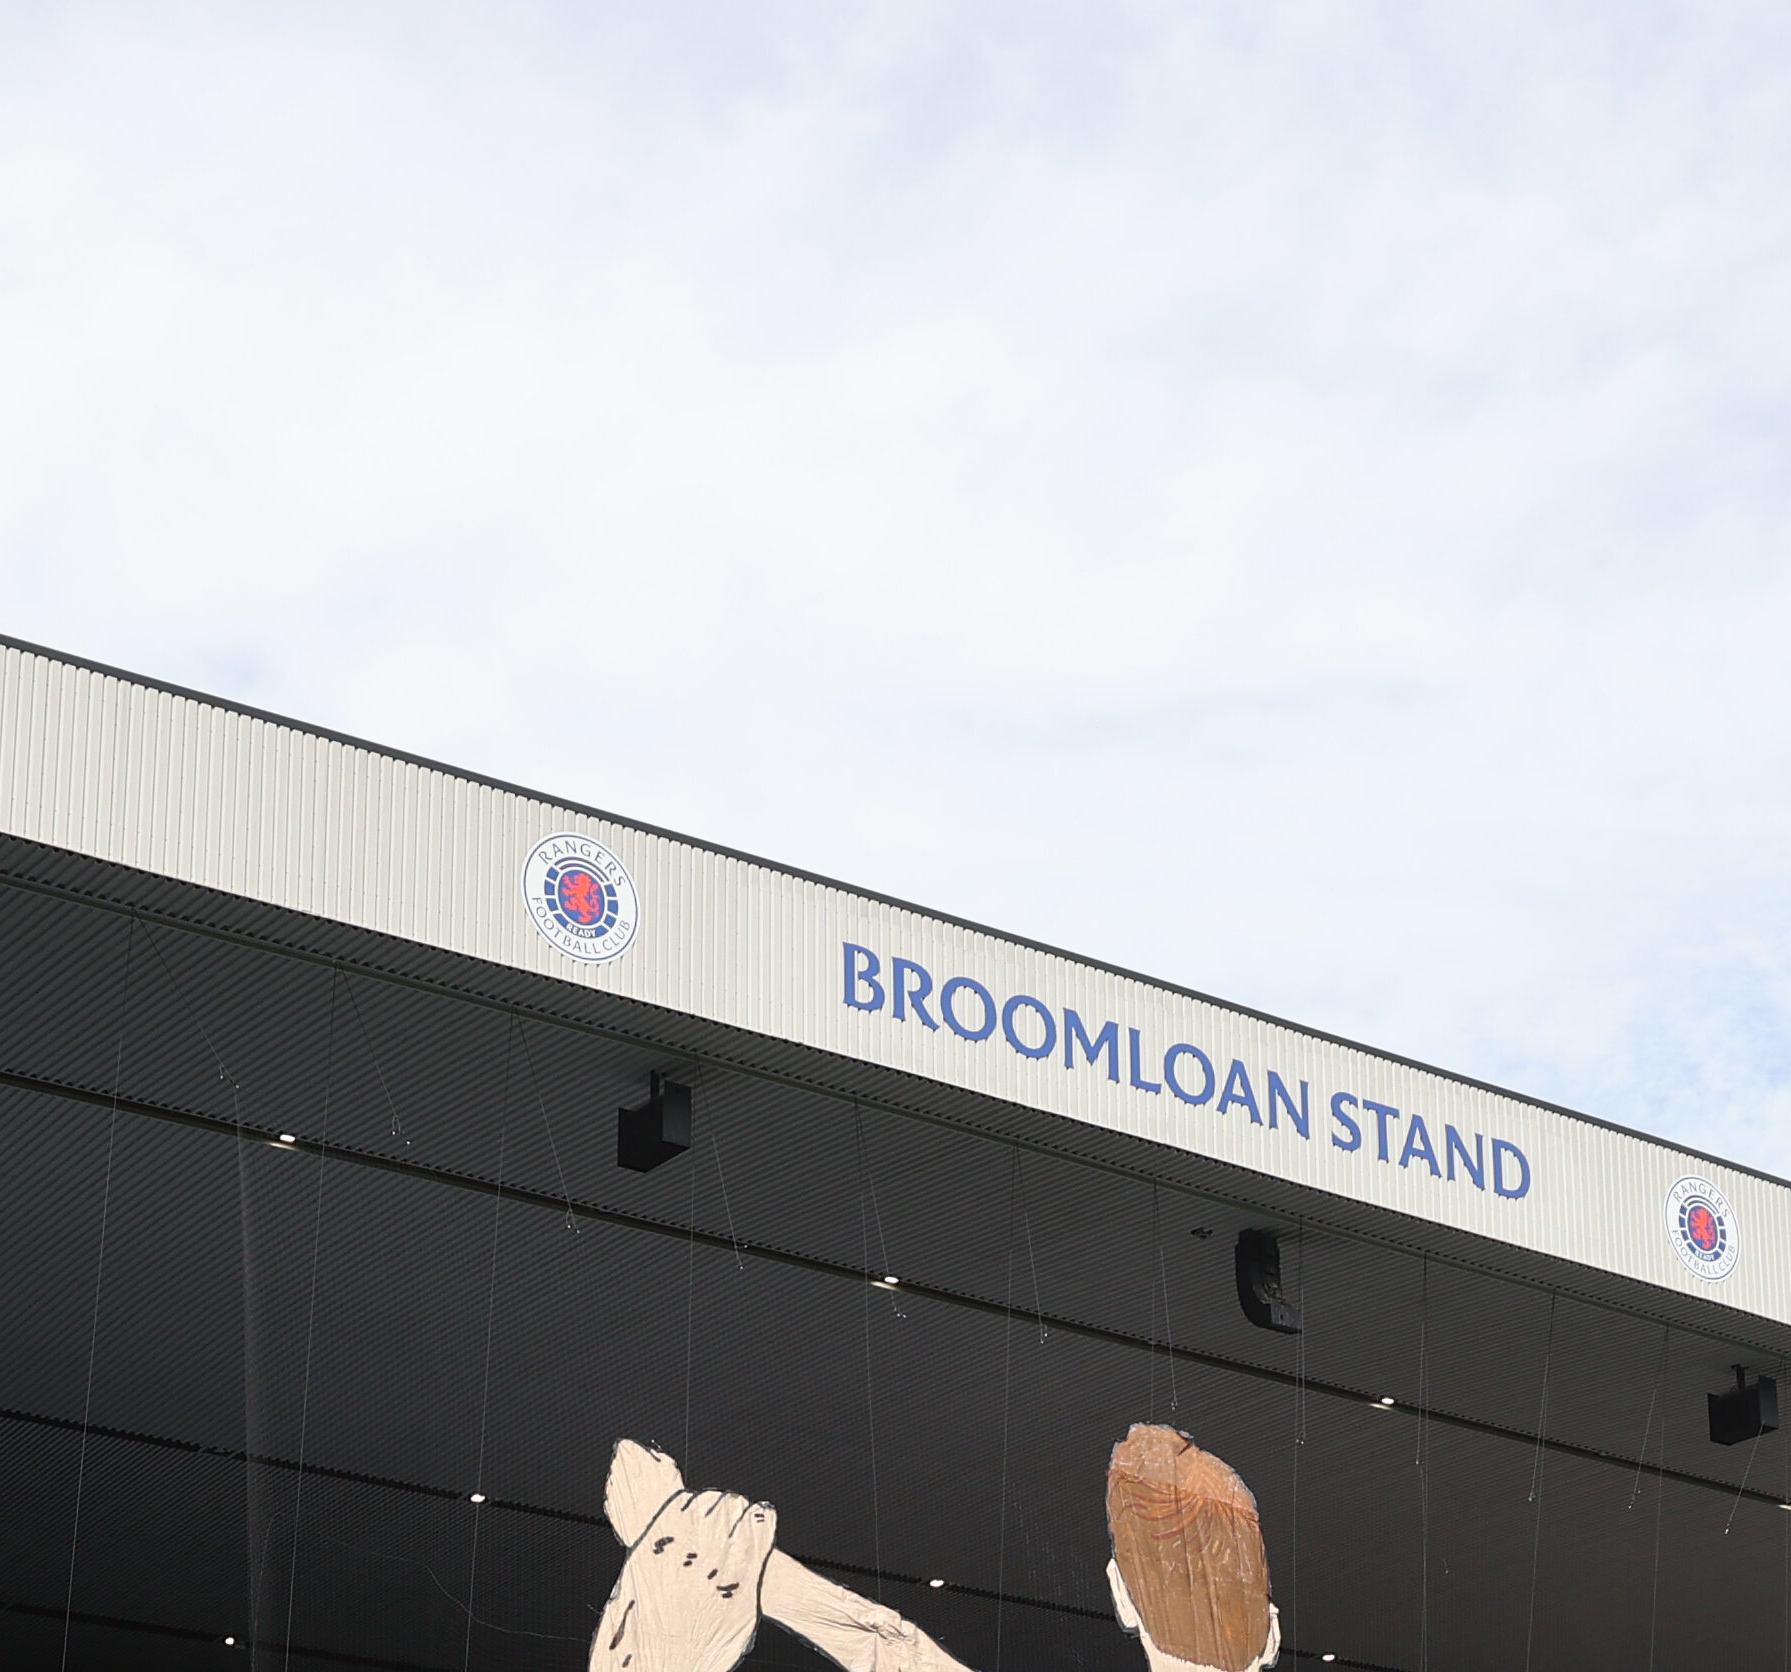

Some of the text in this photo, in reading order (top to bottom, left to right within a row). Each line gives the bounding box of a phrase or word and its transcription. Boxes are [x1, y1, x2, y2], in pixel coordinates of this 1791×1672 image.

[539, 840, 626, 887] RANGERS
[532, 897, 630, 954] FOOTBALL CLUB
[566, 923, 596, 937] READY
[842, 942, 1530, 1200] BROOMLOAN STAND
[1673, 1182, 1729, 1217] RANGERS
[1672, 1230, 1735, 1274] FOOTBALL CLUB
